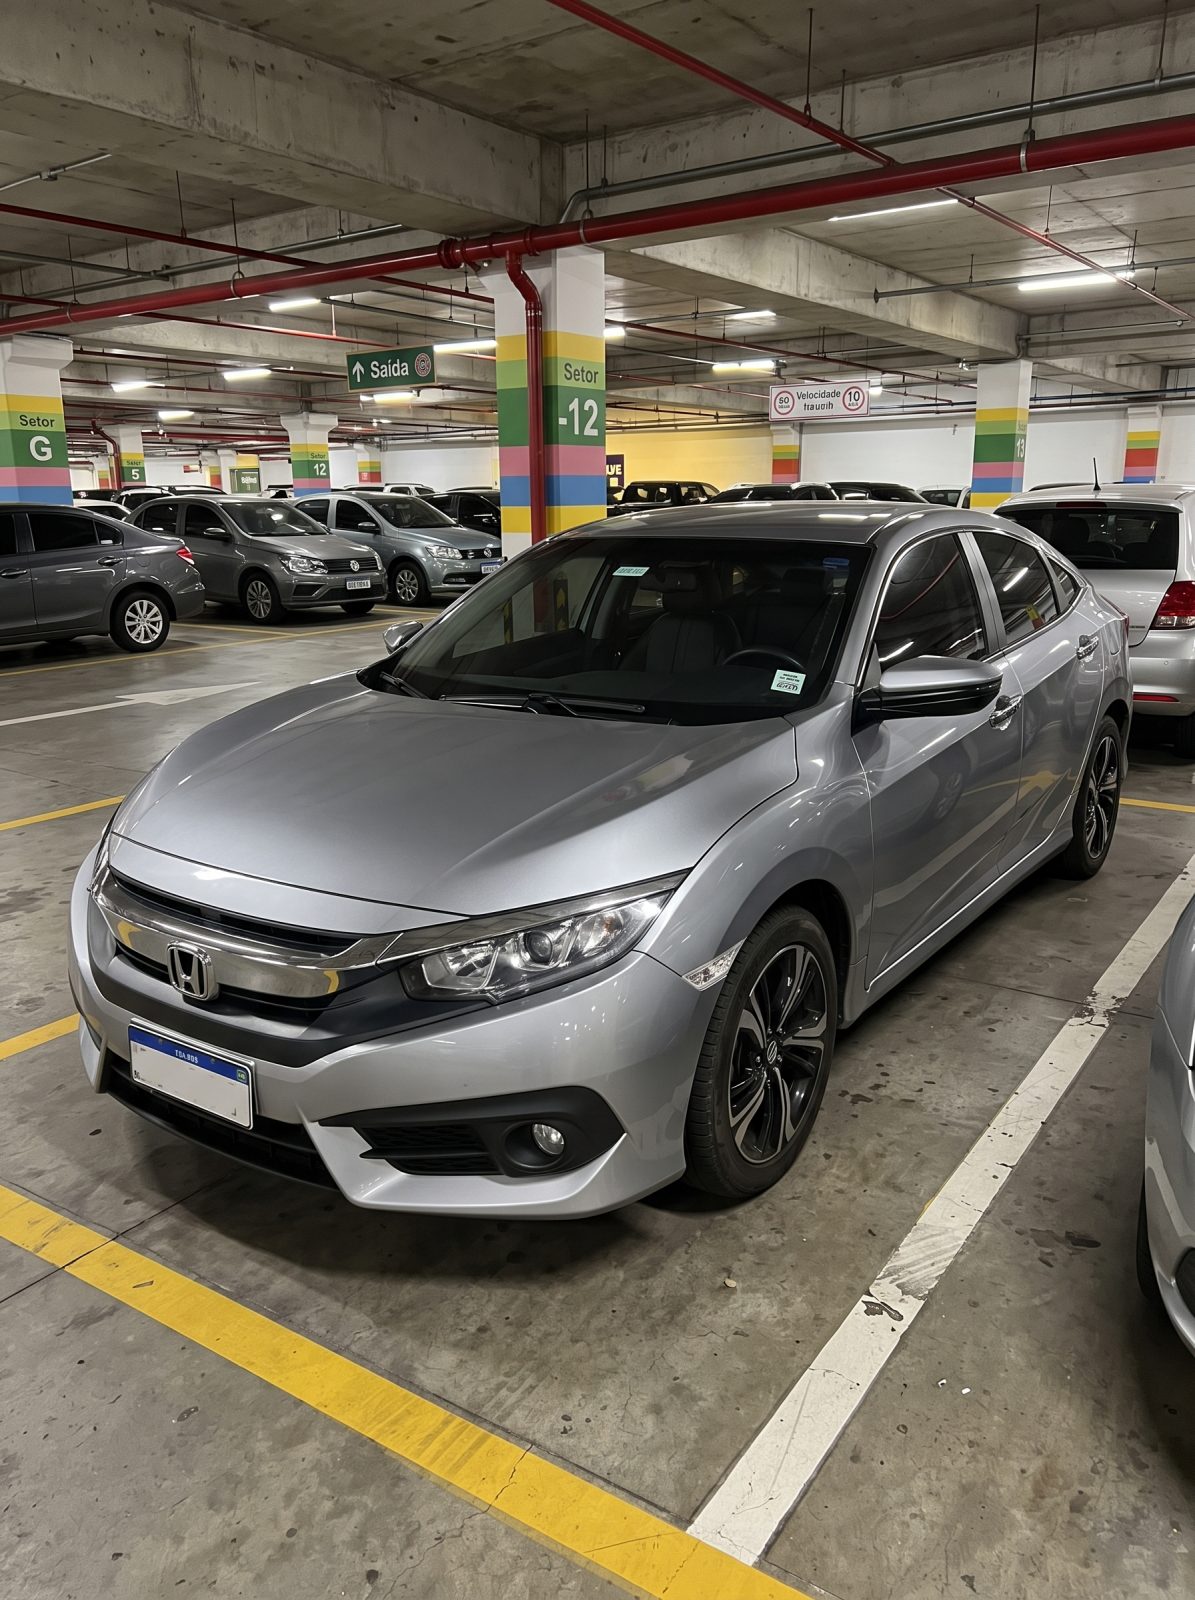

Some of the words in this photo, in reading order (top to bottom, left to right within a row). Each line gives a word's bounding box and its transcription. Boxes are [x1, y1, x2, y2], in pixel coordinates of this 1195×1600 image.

[370, 358, 409, 378] Saída
[564, 363, 598, 383] Setor
[796, 390, 840, 400] Velocidade
[848, 391, 860, 402] 10
[19, 414, 55, 427] Setor
[30, 435, 52, 461] G
[132, 468, 140, 480] 5
[314, 463, 327, 475] 12
